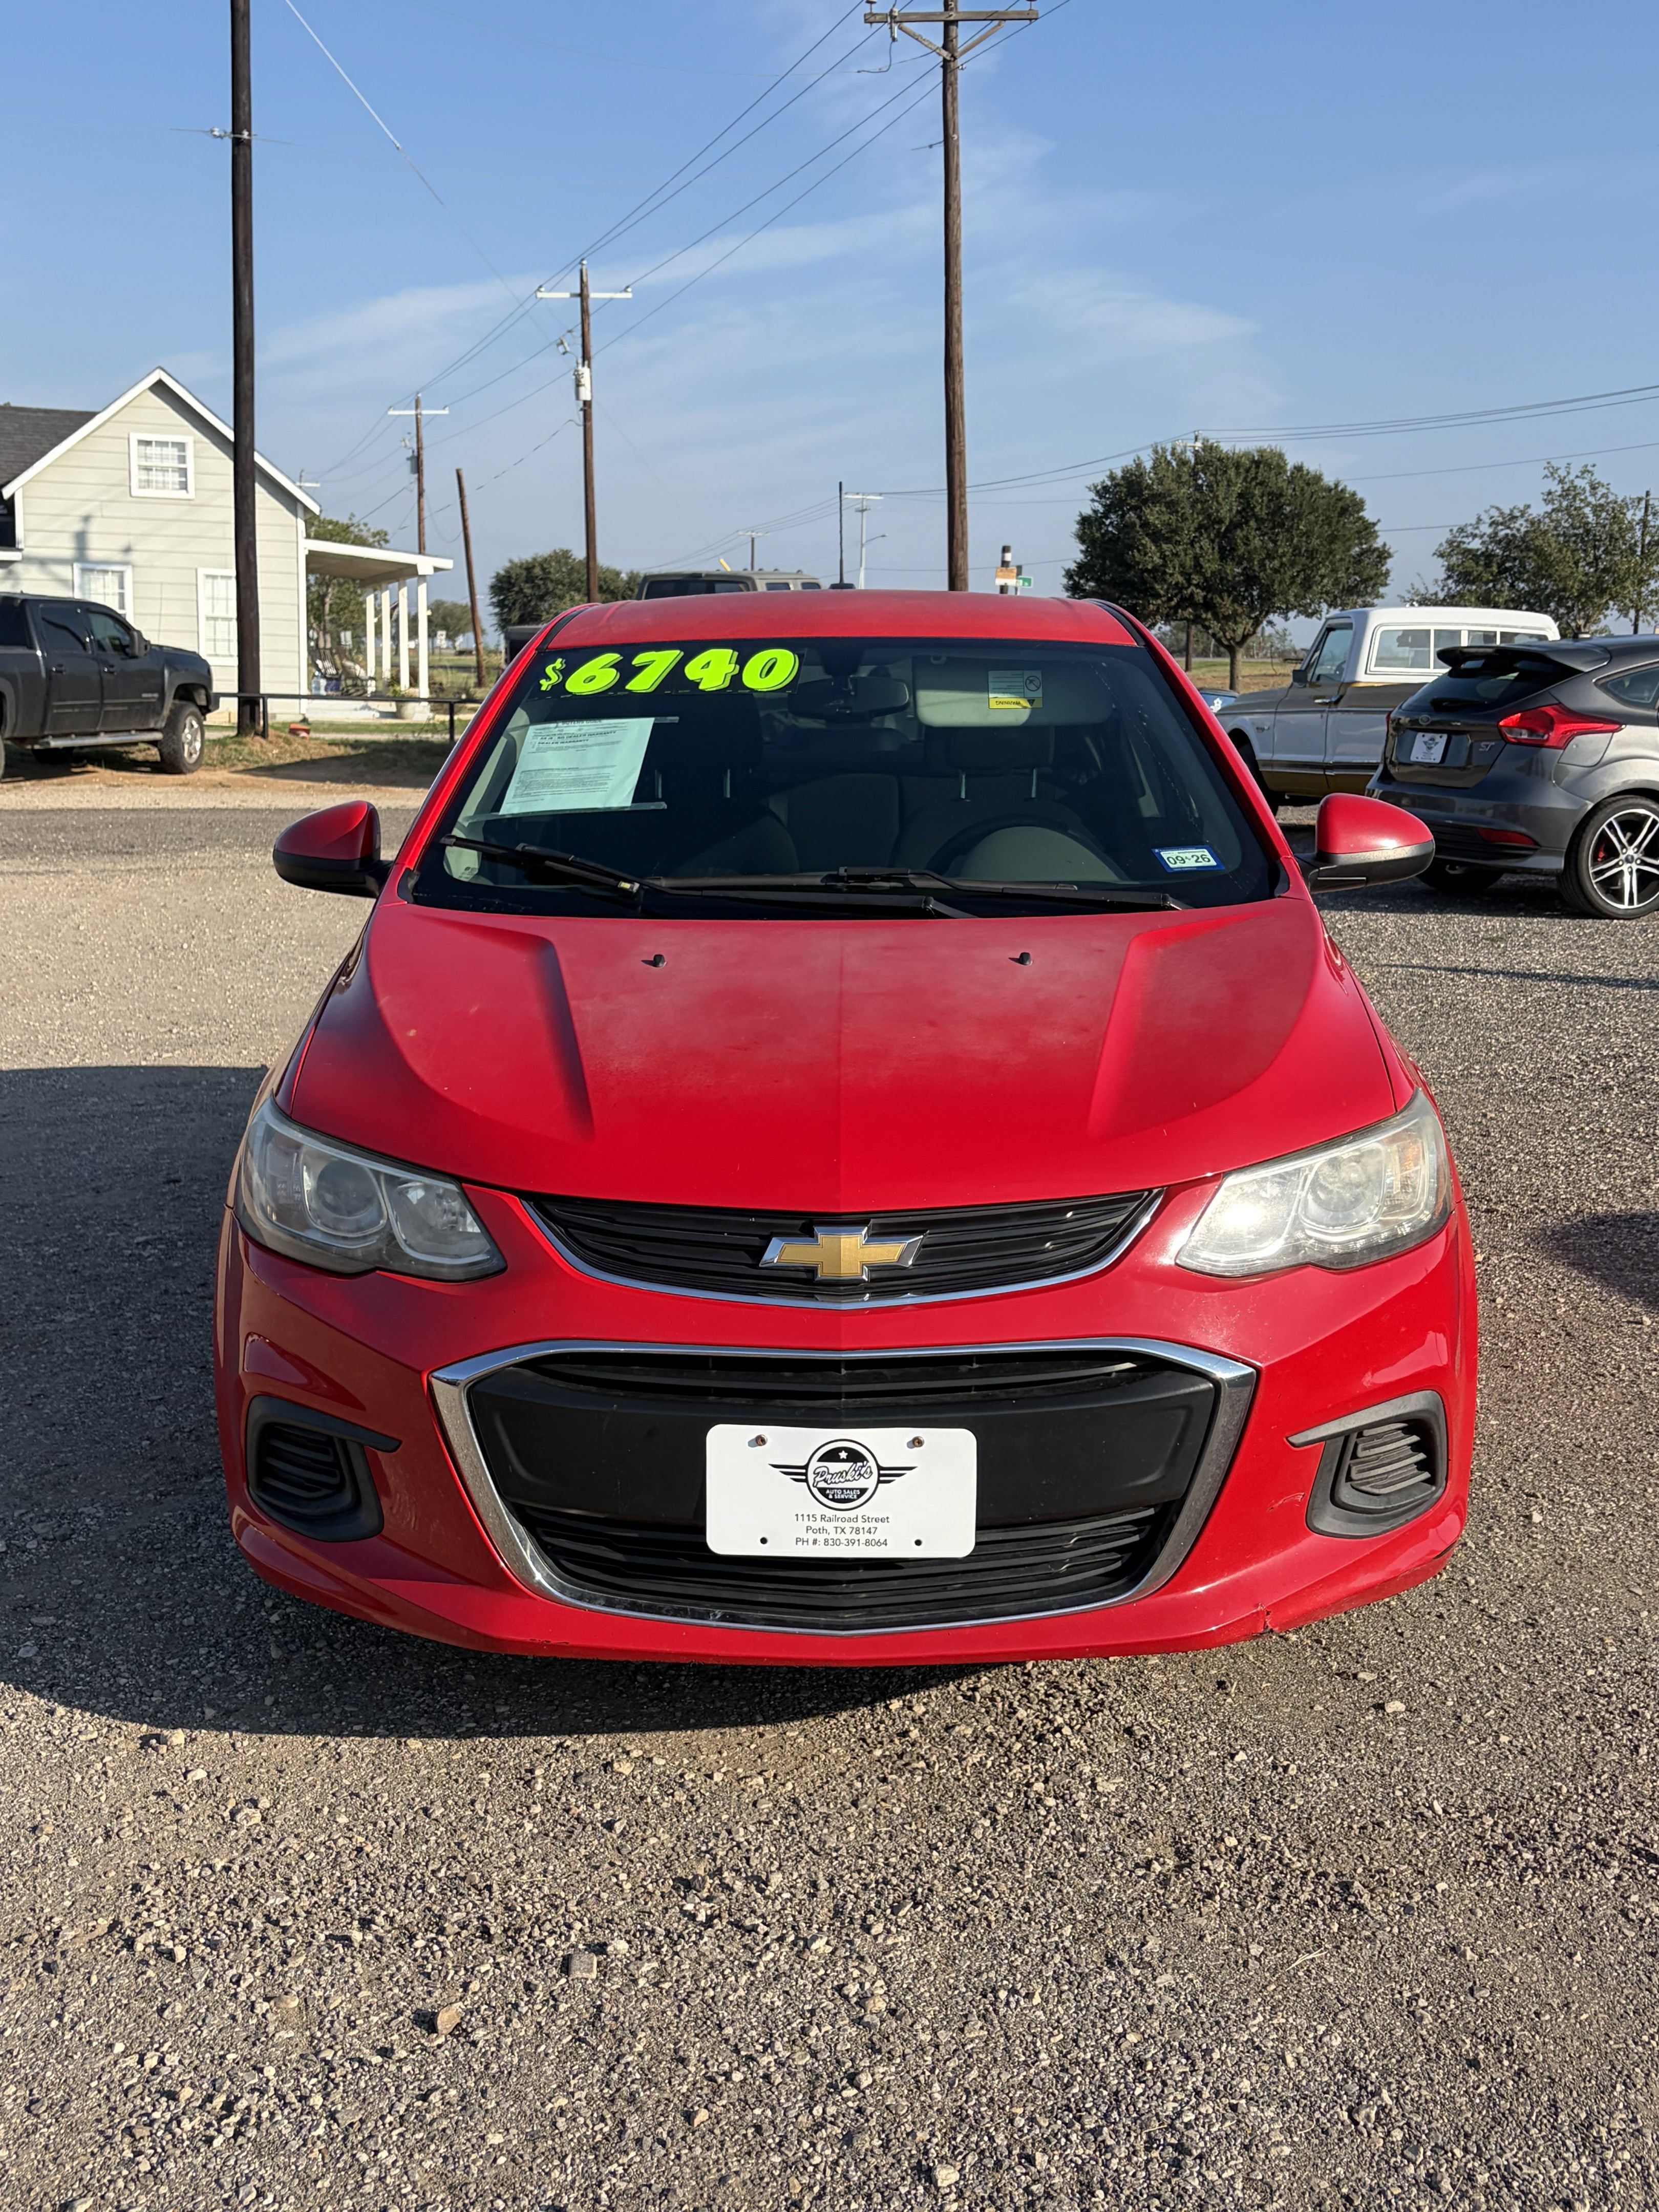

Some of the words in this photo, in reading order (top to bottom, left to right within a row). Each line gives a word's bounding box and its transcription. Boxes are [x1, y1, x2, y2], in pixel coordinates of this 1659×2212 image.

[539, 648, 799, 695] $6740
[1478, 742, 1495, 751] ST
[812, 1460, 873, 1488] Pruski's
[795, 1513, 817, 1522] 1115
[820, 1514, 859, 1523] Railroad
[861, 1515, 890, 1523] Street
[805, 1525, 831, 1536] Poth,
[833, 1526, 846, 1535] TX
[848, 1526, 878, 1535] 78147
[795, 1537, 809, 1546] PH
[823, 1538, 888, 1547] 830-391-8064
